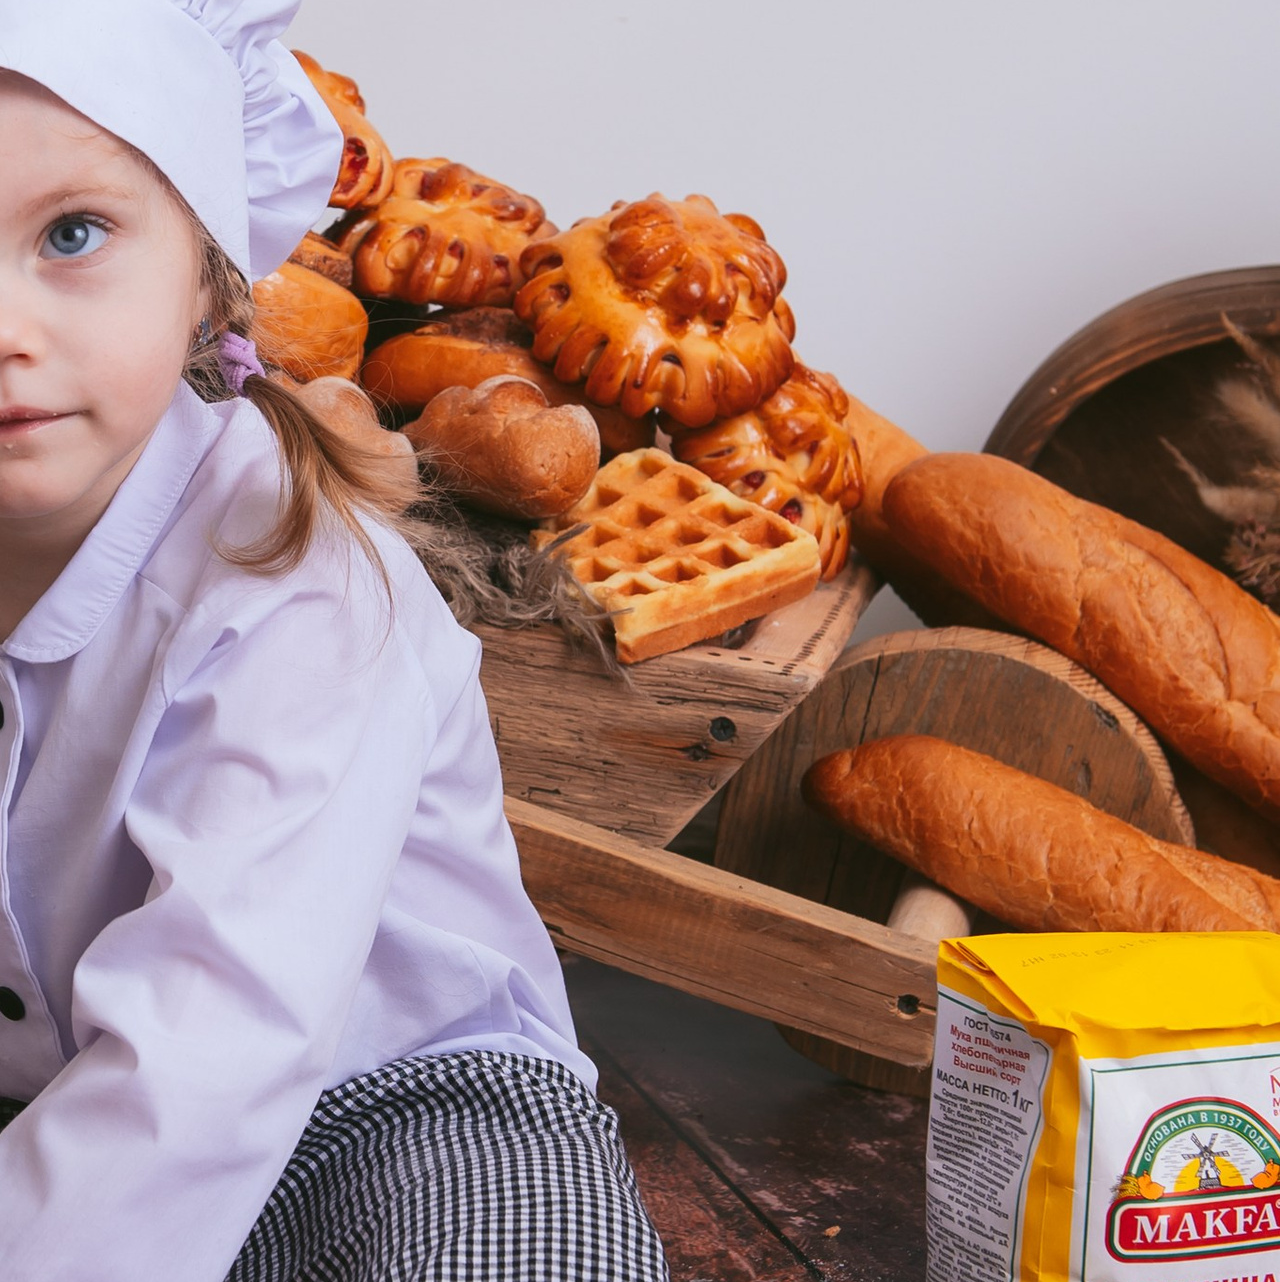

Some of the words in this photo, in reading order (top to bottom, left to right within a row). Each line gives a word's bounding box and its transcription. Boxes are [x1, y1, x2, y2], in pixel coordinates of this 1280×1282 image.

[950, 1024, 971, 1043] Мука
[964, 1016, 988, 1032] ГОСТ
[937, 1068, 969, 1092] МАССА
[973, 1083, 1010, 1104] НЕТТО:
[1000, 1071, 1021, 1086] сорт
[1144, 1112, 1195, 1162] ОСНОВАНА
[1200, 1112, 1208, 1123] В
[1214, 1112, 1242, 1129] 1937
[1243, 1120, 1270, 1151] ГОДУ
[1132, 1202, 1280, 1245] MAKFA
